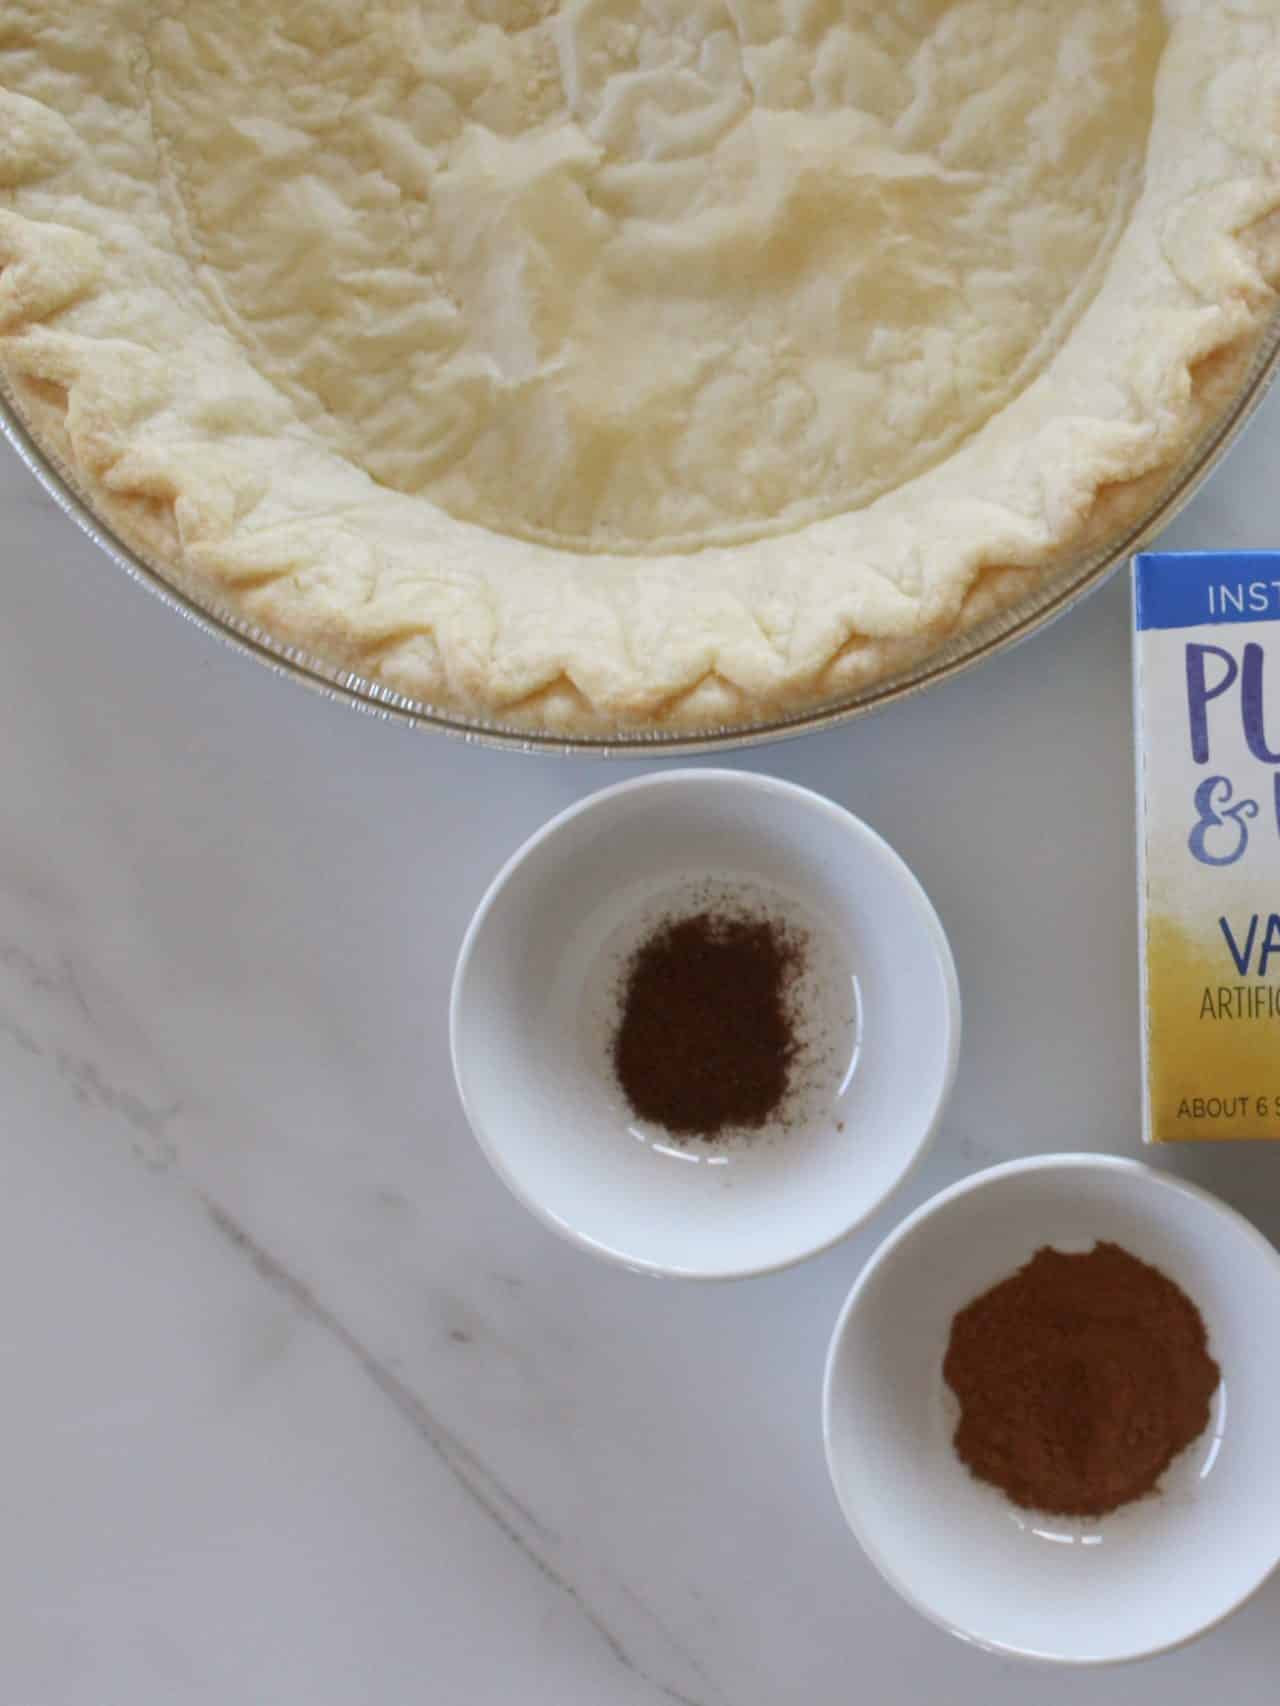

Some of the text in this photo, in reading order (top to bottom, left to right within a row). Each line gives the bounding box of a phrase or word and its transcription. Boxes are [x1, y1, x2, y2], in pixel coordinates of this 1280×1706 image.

[1187, 775, 1260, 866] &
[1176, 1095, 1250, 1119] ABOUT
[1255, 1096, 1270, 1118] 6
